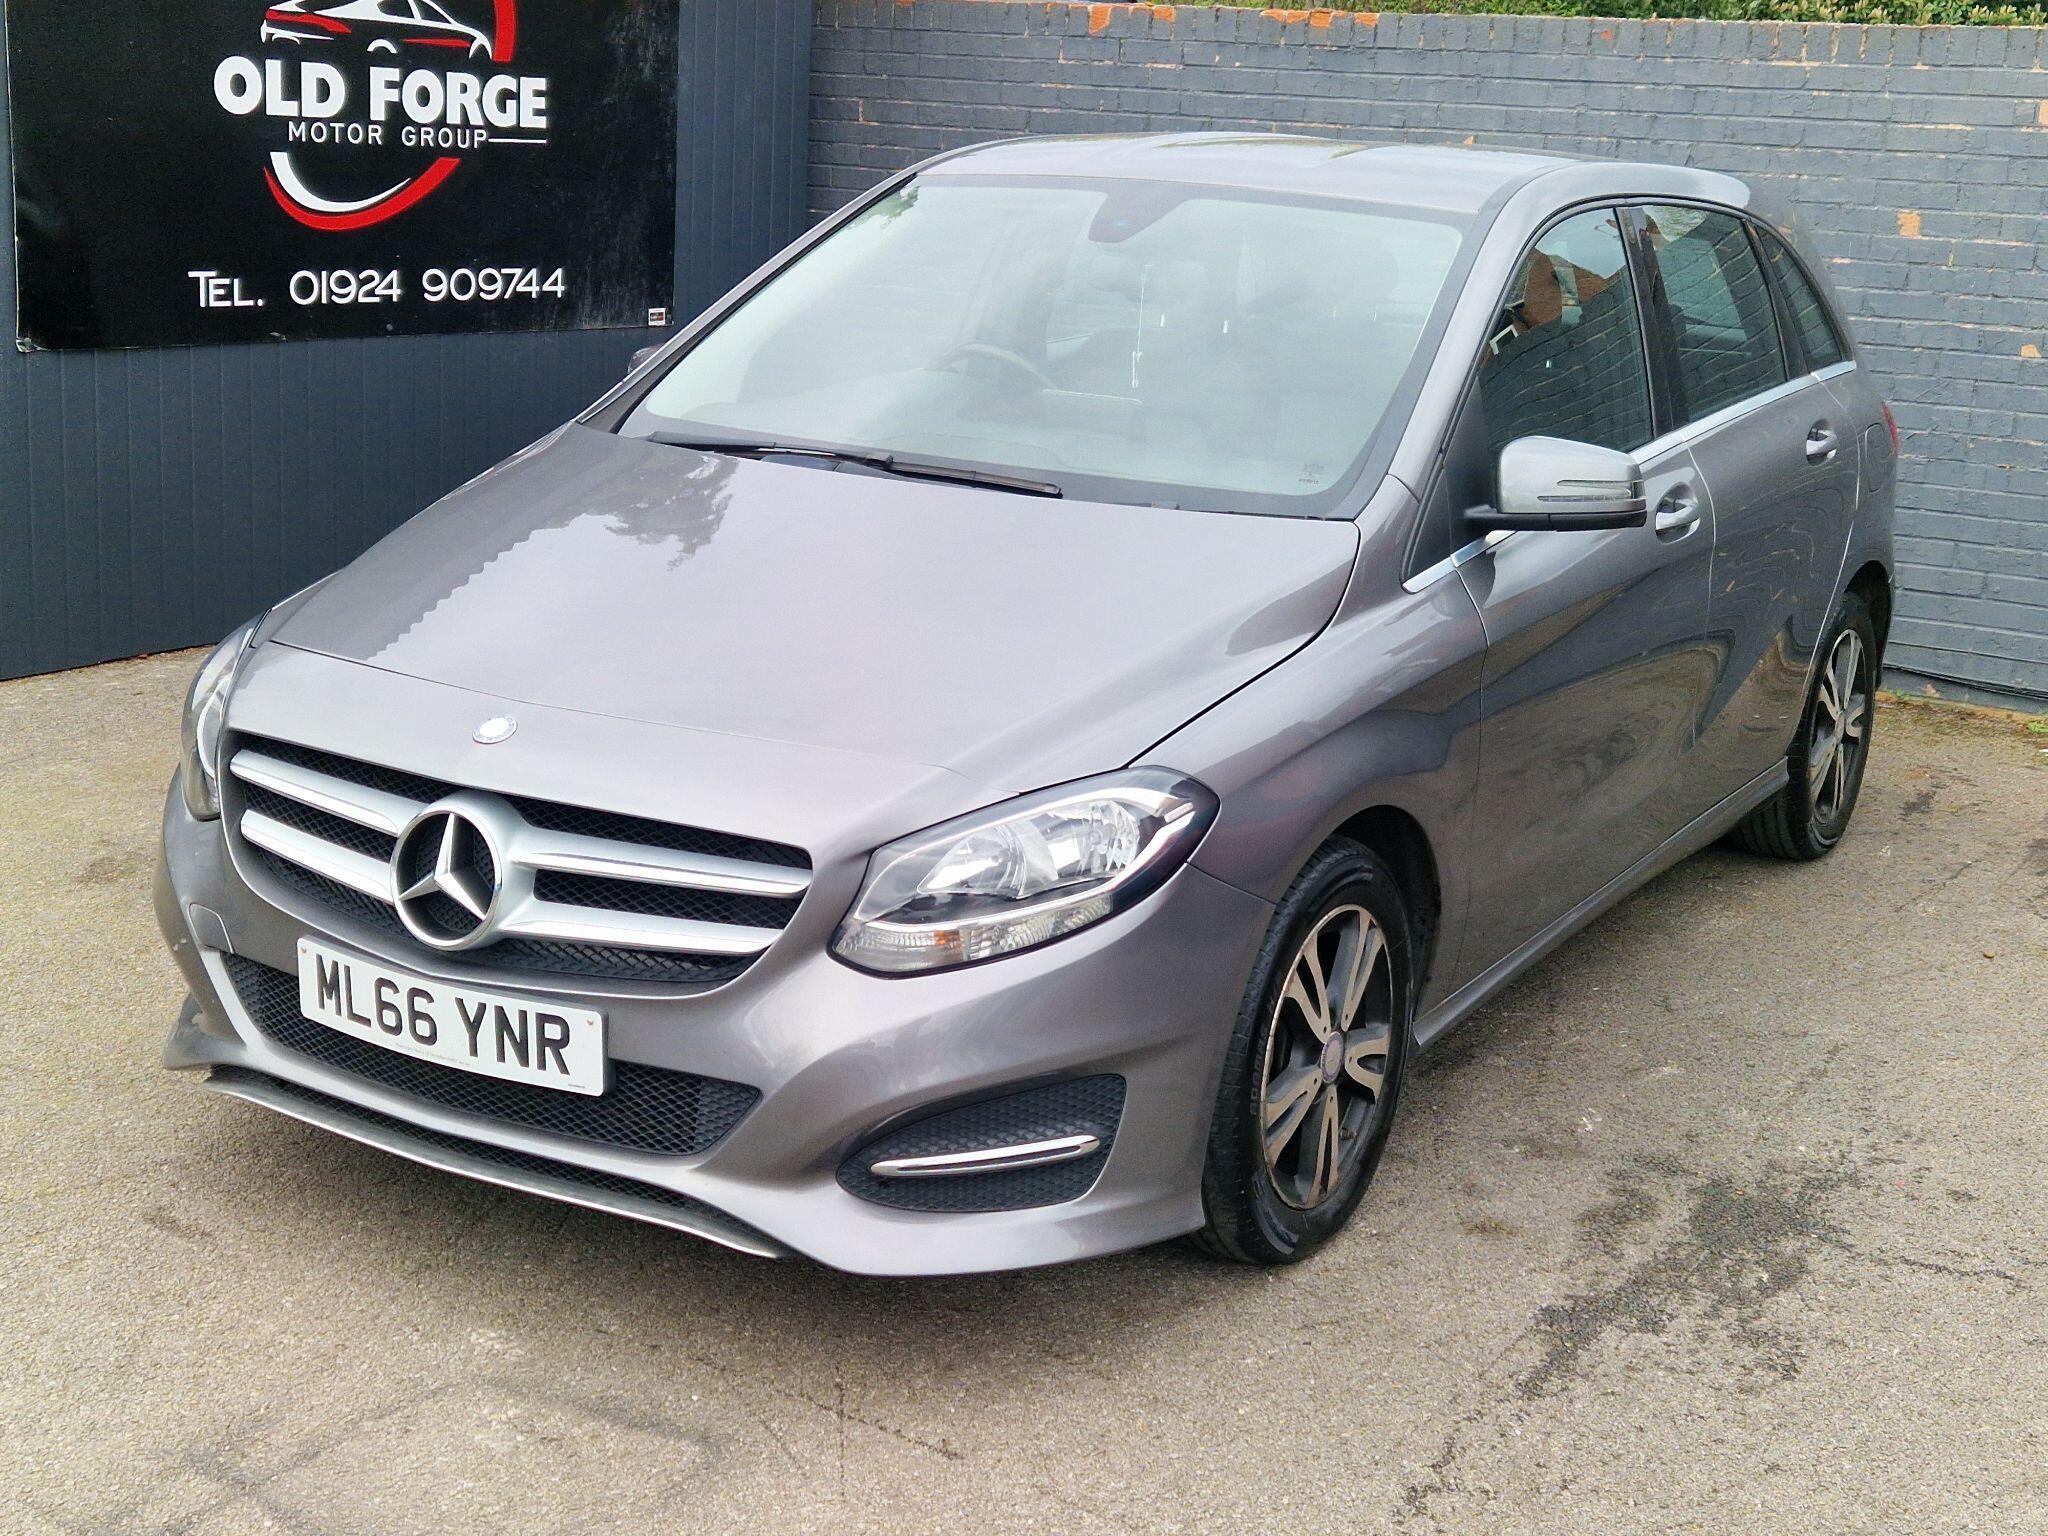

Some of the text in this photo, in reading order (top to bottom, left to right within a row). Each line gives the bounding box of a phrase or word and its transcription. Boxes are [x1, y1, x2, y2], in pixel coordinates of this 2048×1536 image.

[213, 55, 546, 129] OLD FORGE
[288, 121, 488, 149] MOTOR GROUP
[289, 269, 401, 305] 01924
[422, 267, 565, 301] 909744
[315, 953, 571, 1076] ML66 YNR
